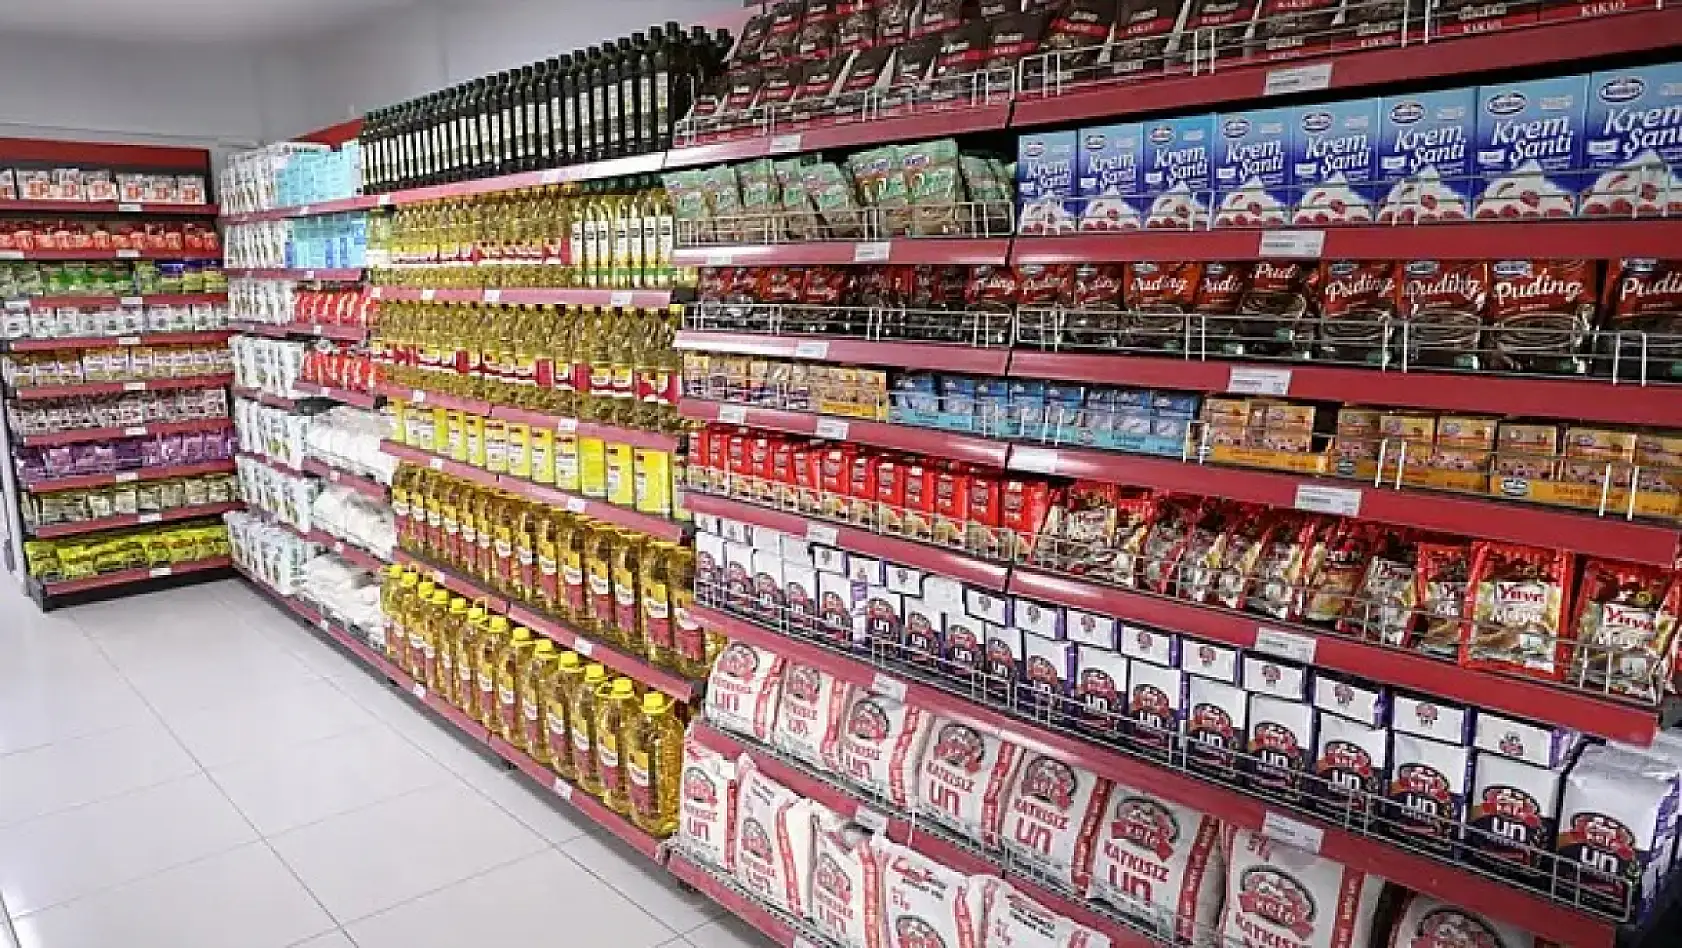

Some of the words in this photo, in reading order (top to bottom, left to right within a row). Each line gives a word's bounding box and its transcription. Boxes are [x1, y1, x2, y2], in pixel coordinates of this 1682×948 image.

[1394, 124, 1462, 152] Krem
[1490, 116, 1569, 145] Krem
[1154, 147, 1206, 169] Krem
[1225, 139, 1281, 164] Krem
[1305, 134, 1368, 159] Krem
[1493, 262, 1584, 301] Puding
[1102, 840, 1171, 883] KATKISIZ
